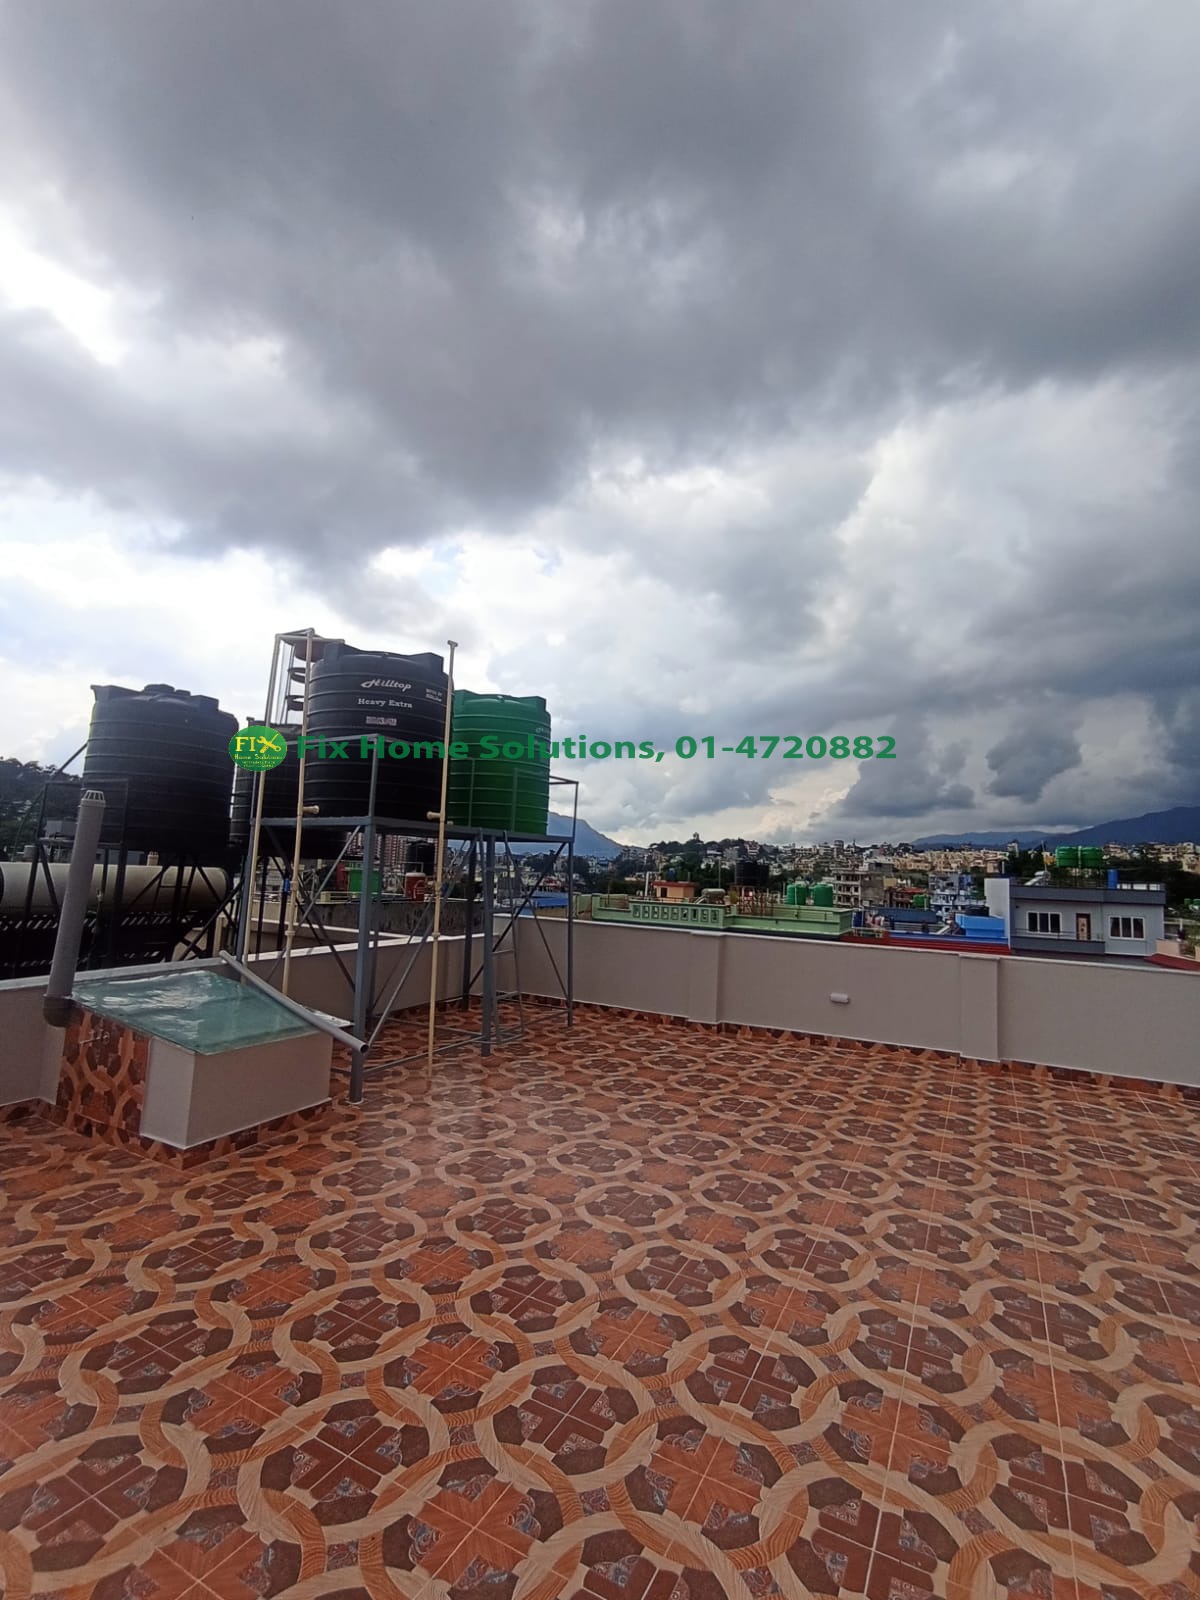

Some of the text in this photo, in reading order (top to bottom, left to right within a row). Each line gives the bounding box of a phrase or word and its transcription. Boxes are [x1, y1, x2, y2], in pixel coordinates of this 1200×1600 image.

[361, 679, 412, 692] Hilltop
[358, 698, 413, 708] Heavy Extra
